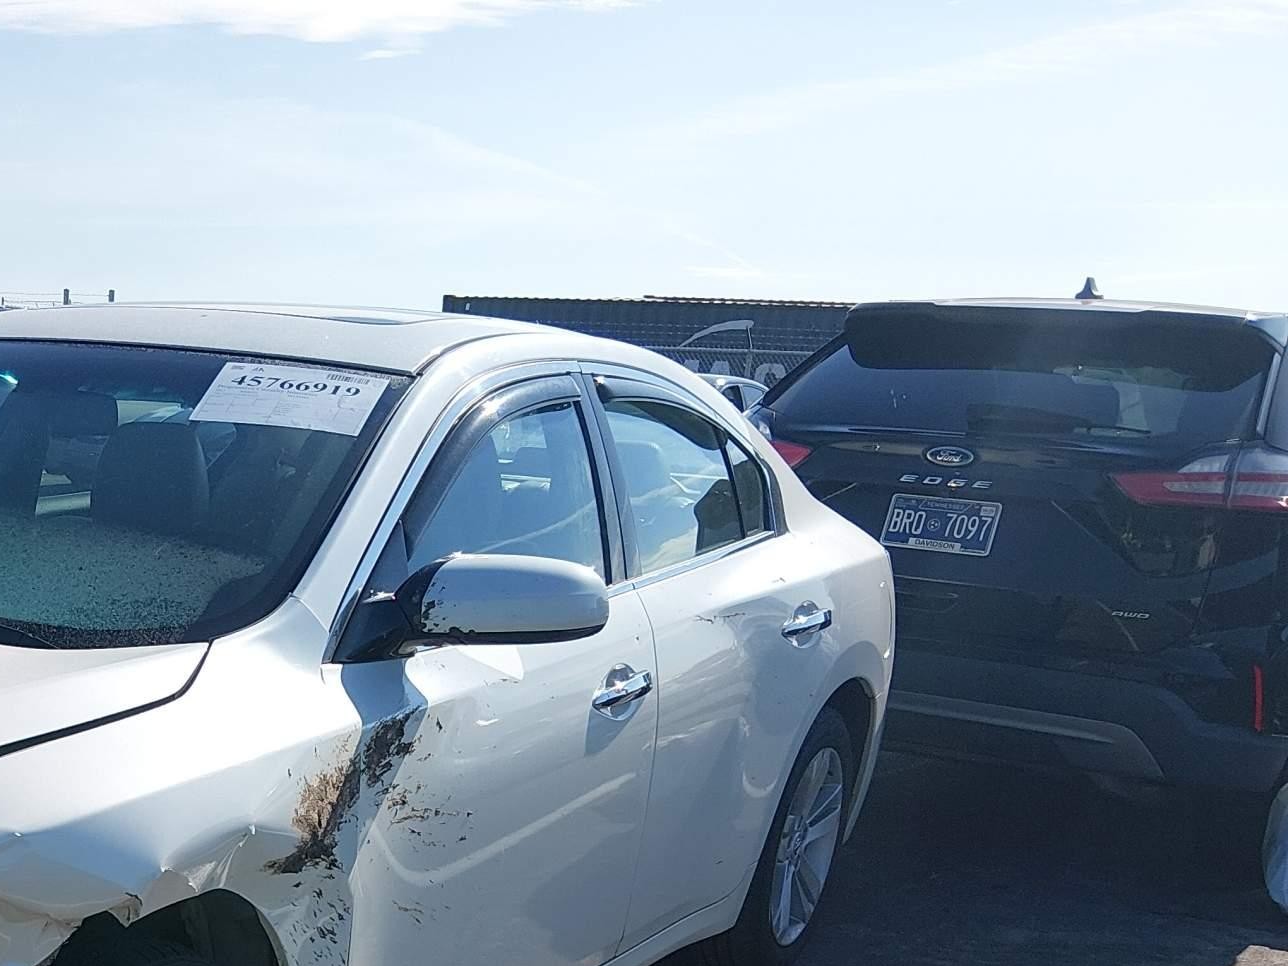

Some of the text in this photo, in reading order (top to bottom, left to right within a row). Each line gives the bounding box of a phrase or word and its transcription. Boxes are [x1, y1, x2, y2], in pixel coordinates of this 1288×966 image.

[231, 374, 361, 397] 45766919
[936, 450, 962, 462] Ford
[899, 474, 993, 489] EDGE
[944, 513, 993, 542] 7097
[914, 538, 956, 551] DAVIDSON
[1112, 610, 1150, 619] AWD
